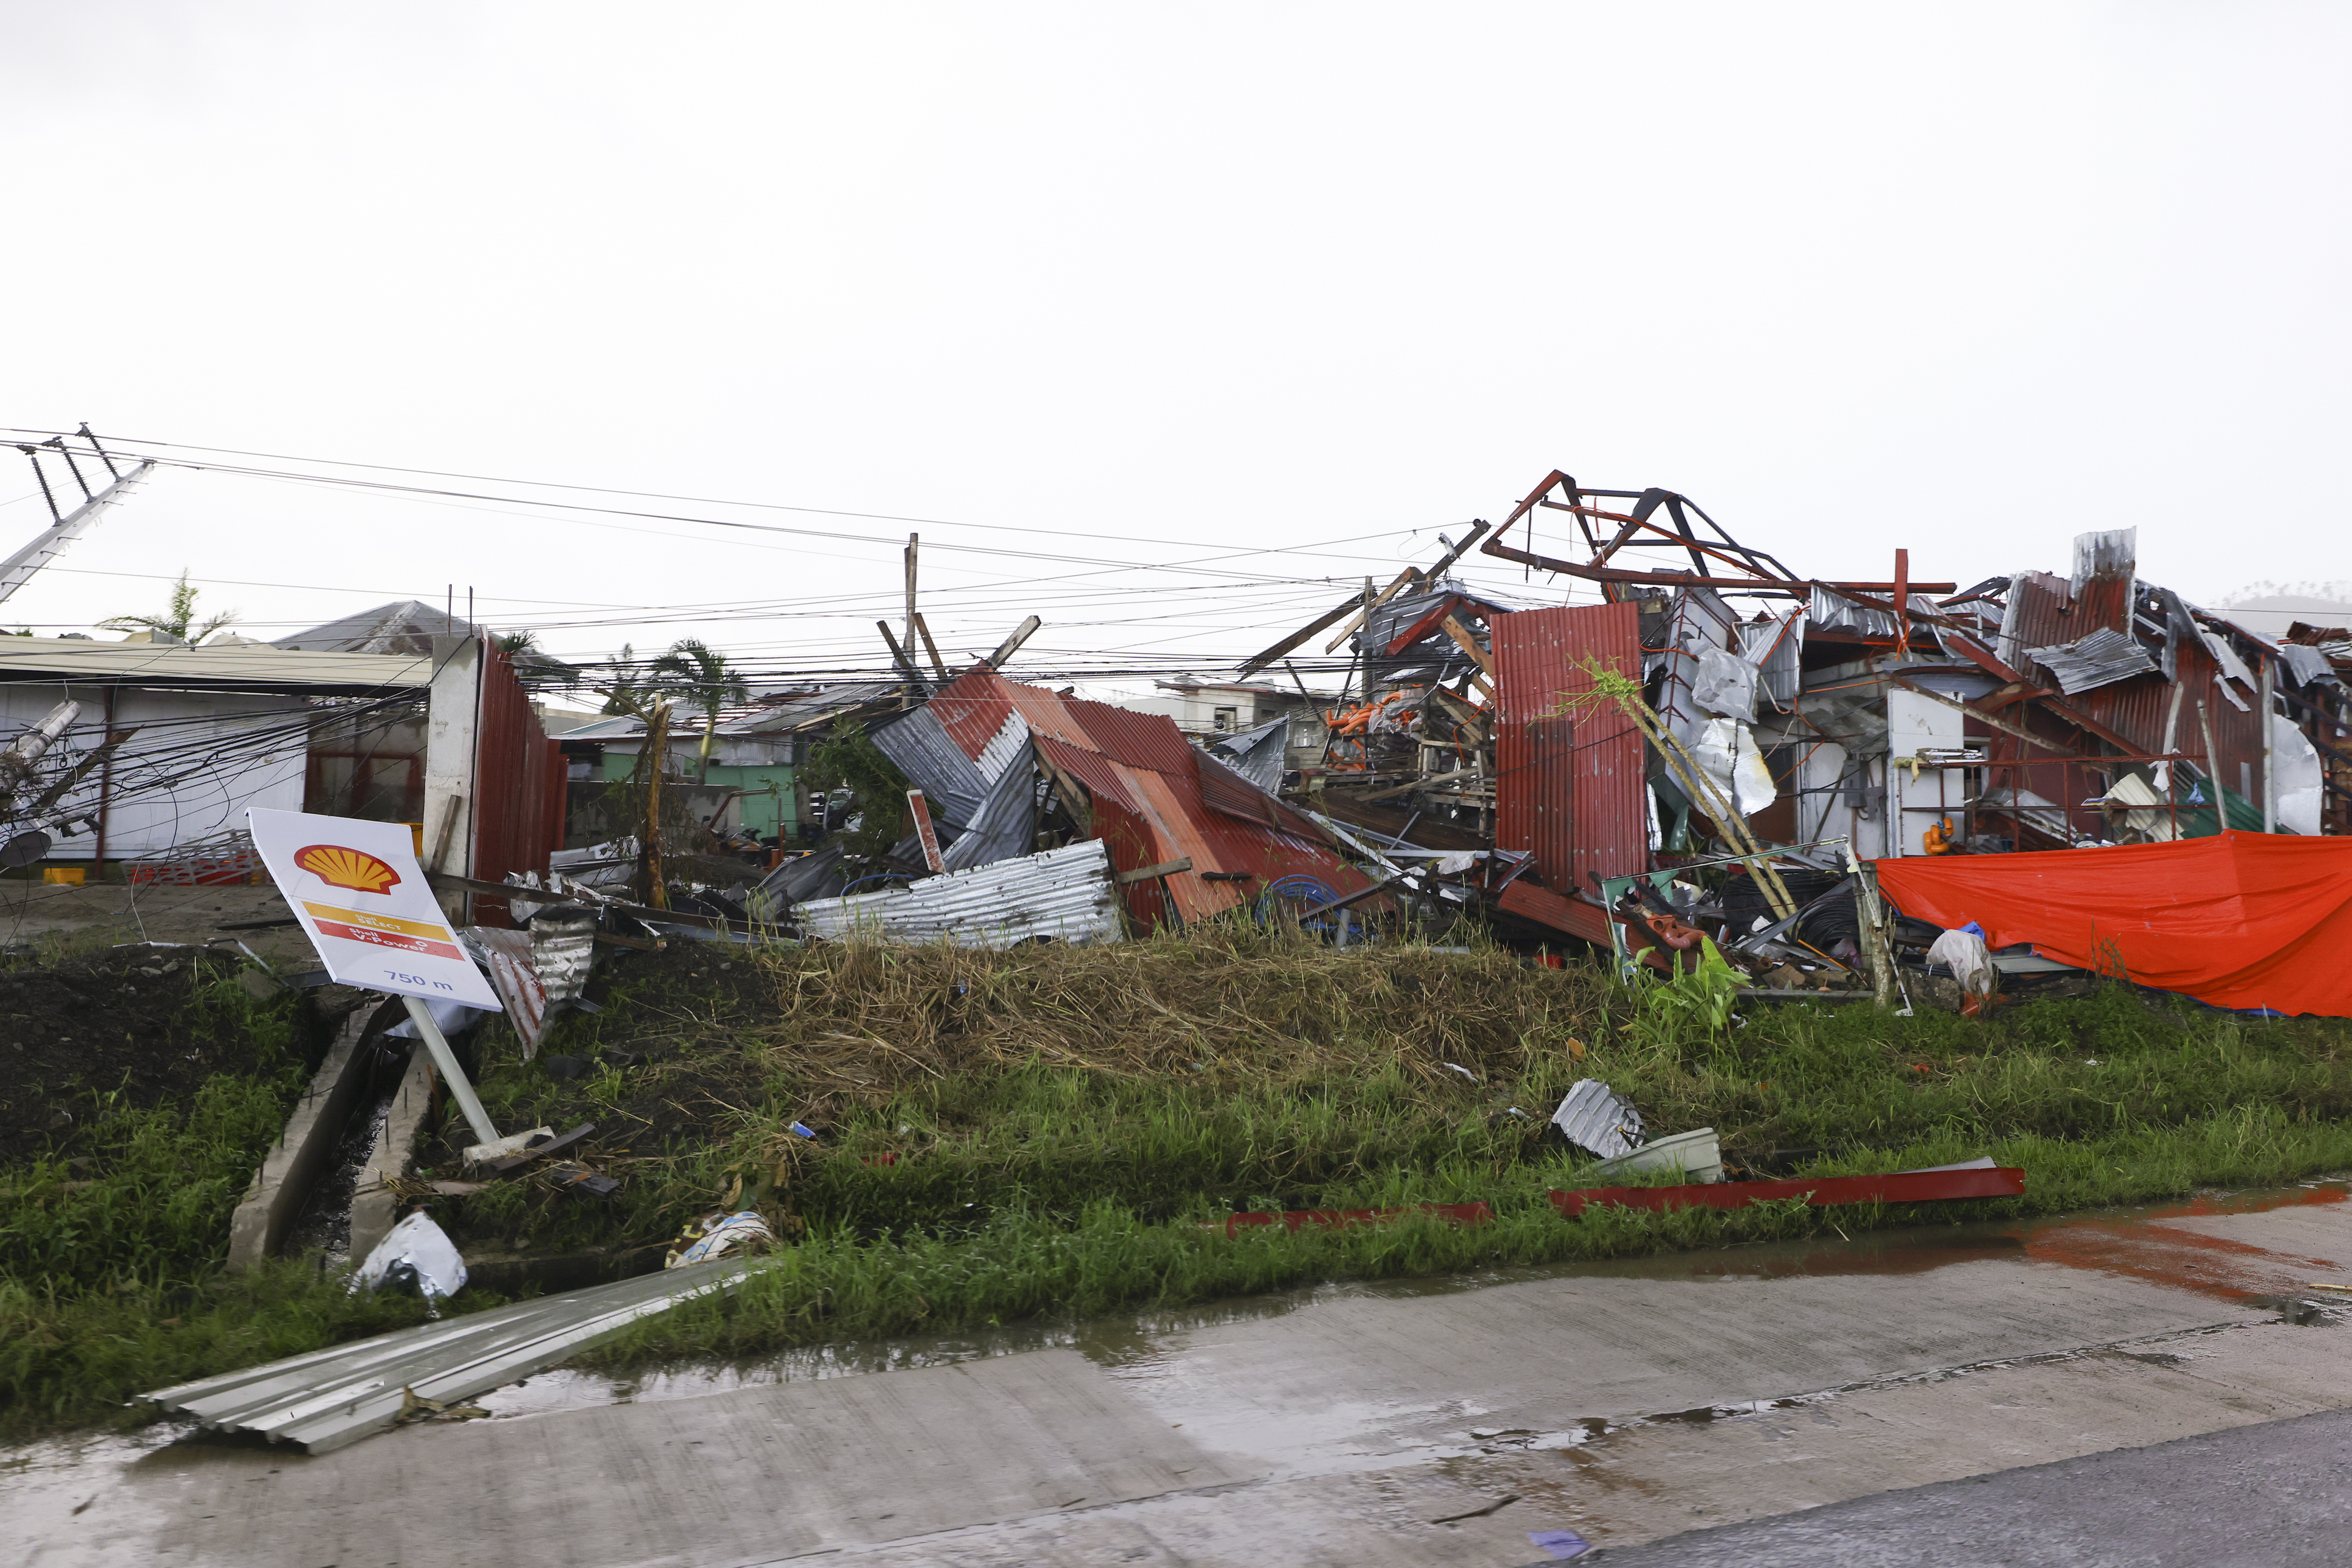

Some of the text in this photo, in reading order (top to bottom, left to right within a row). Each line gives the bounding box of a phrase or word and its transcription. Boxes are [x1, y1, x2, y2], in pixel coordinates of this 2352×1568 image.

[357, 918, 401, 930] SELECT
[349, 927, 378, 938] Shell
[352, 933, 426, 952] V-Power
[383, 970, 453, 991] 750 m
